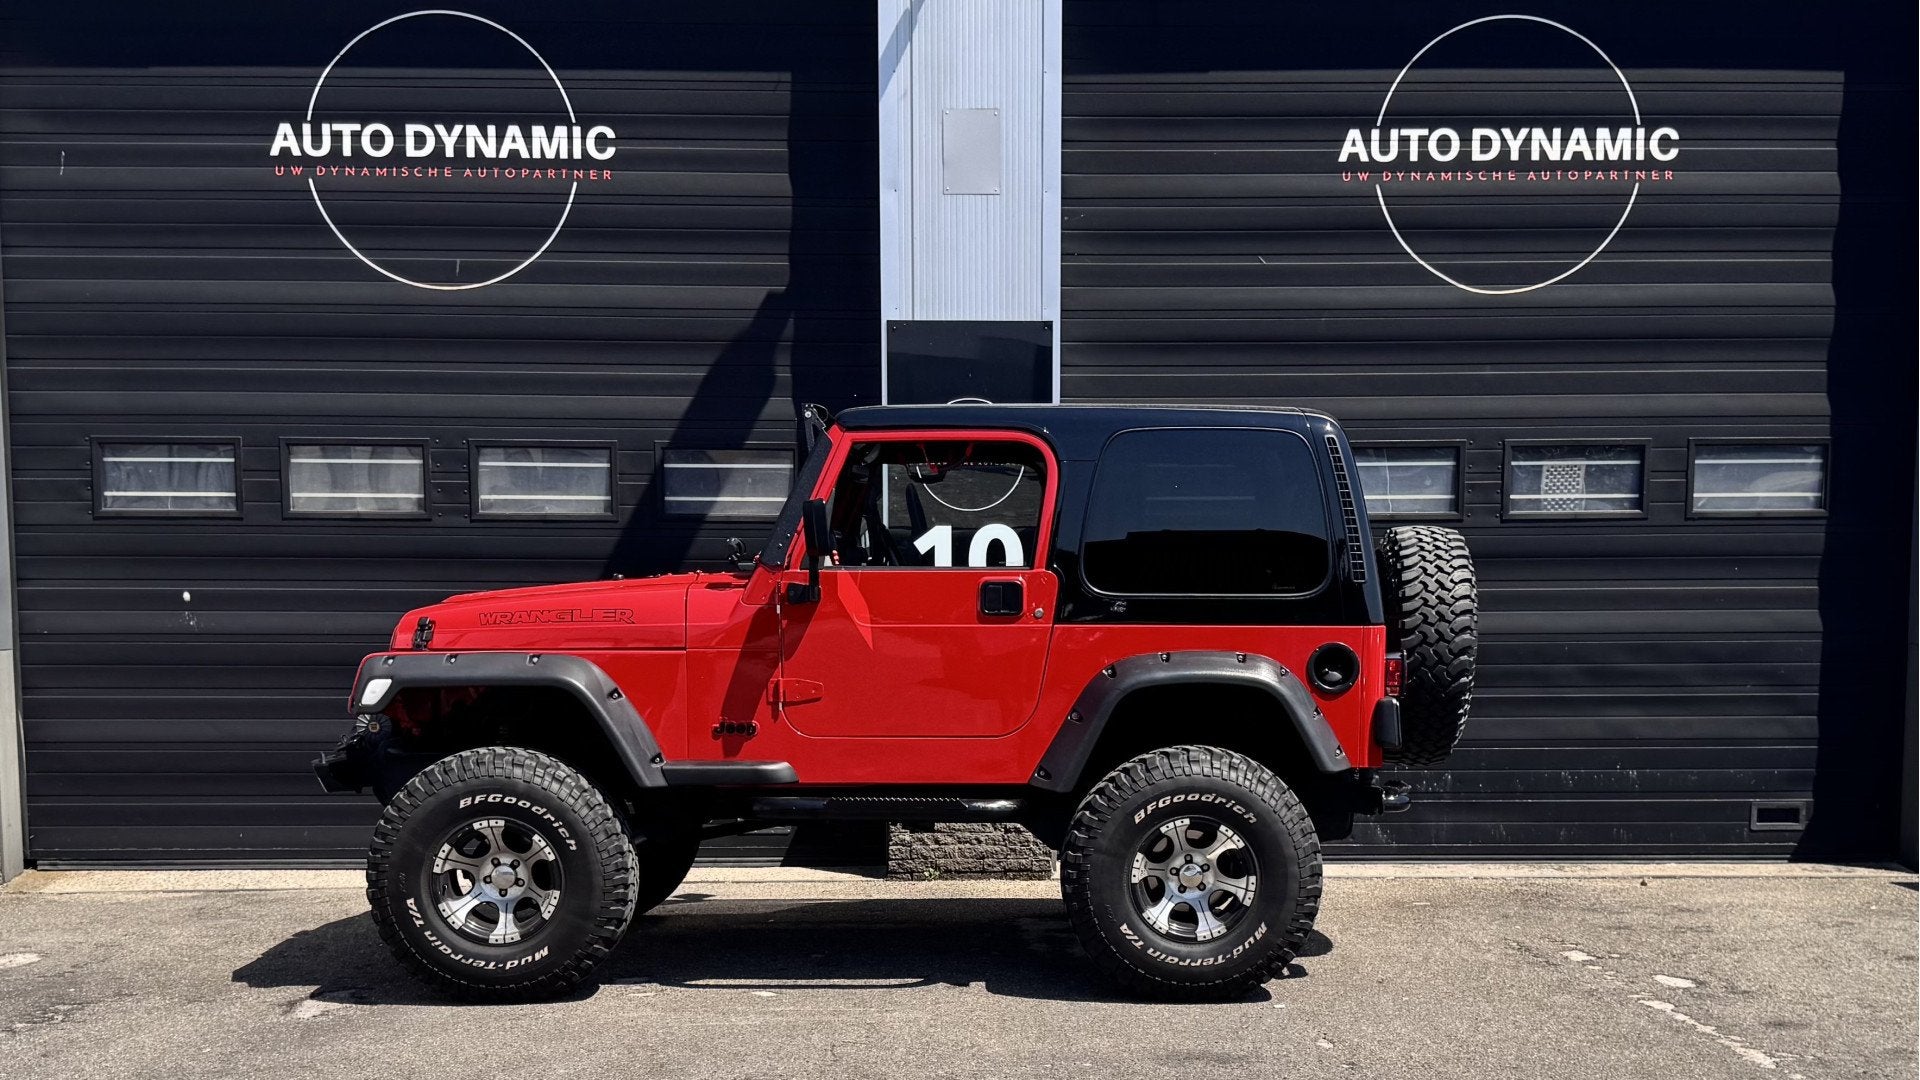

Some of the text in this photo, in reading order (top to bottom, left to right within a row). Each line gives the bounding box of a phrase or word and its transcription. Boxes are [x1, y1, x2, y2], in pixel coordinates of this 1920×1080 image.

[269, 123, 617, 160] AUTO DYNAMIC
[1338, 127, 1680, 163] AUTO DYNAMIC
[275, 165, 613, 181] UW DYNAMISCHE AUTOPARTNER
[1342, 170, 1675, 182] UW DYNAMISCHE AUTOPARTNER
[479, 609, 635, 625] WRANGLER
[459, 793, 577, 851] BFGoodrich
[1134, 792, 1258, 825] BFGoodrich
[406, 897, 550, 971] Mud-Terrain T/A
[1119, 921, 1268, 967] Mud-Terrain T/A
